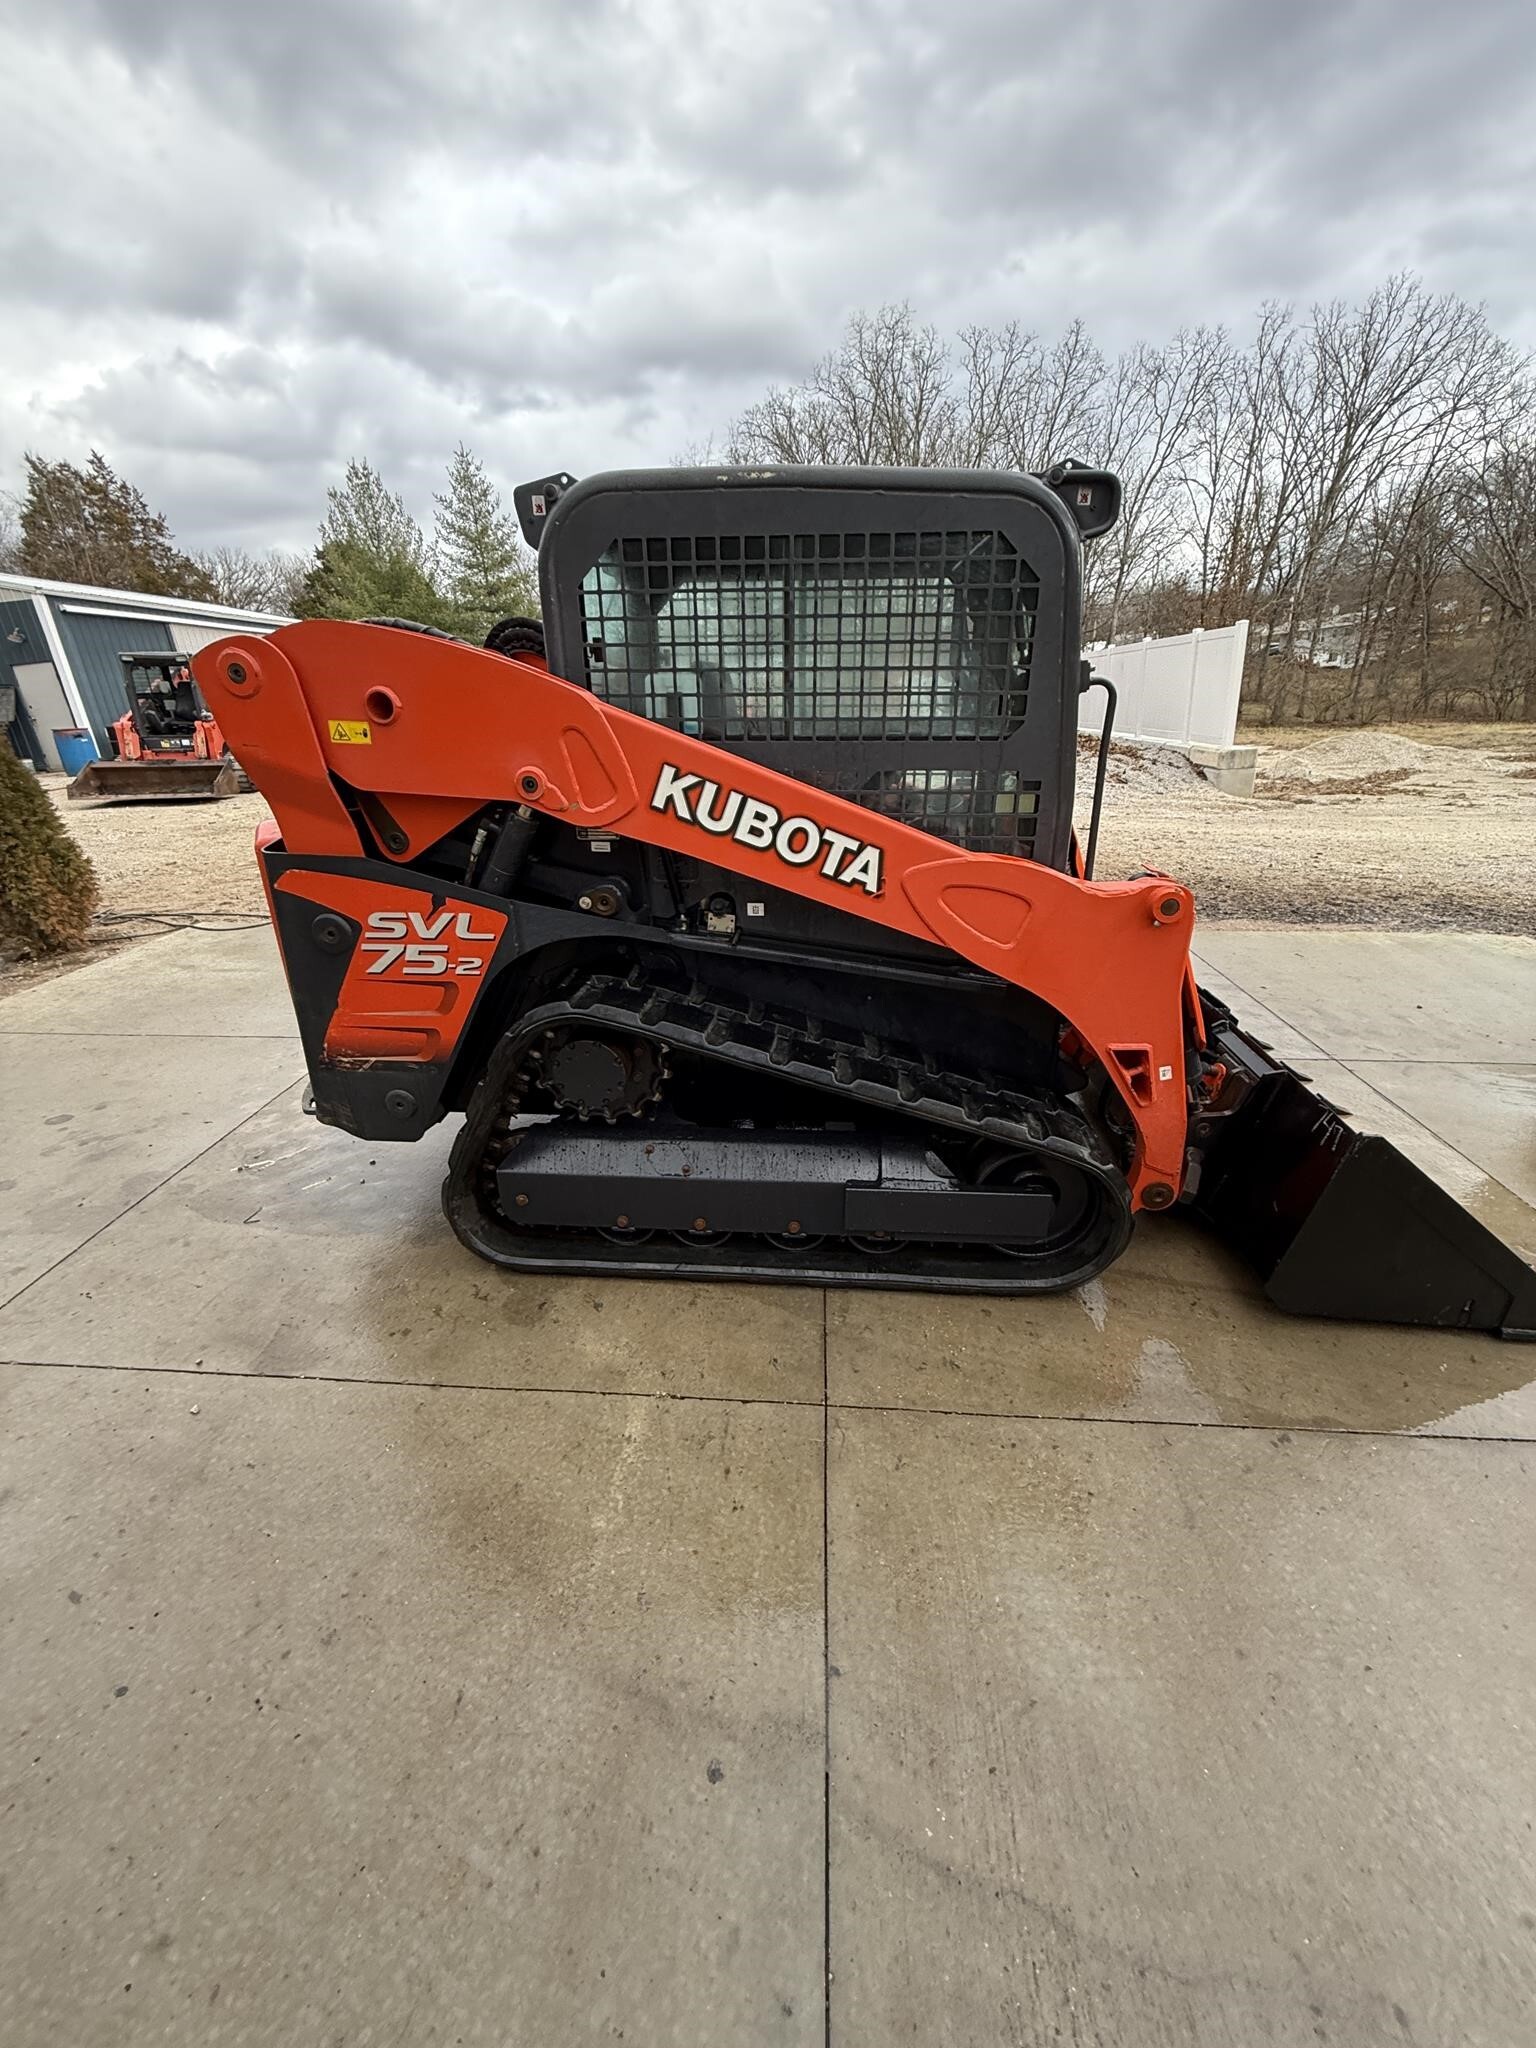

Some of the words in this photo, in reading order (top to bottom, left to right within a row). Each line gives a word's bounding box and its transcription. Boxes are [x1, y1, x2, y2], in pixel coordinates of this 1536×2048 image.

[650, 763, 884, 895] KUBOTA
[365, 912, 496, 940] SVL
[361, 943, 483, 976] 75-2
